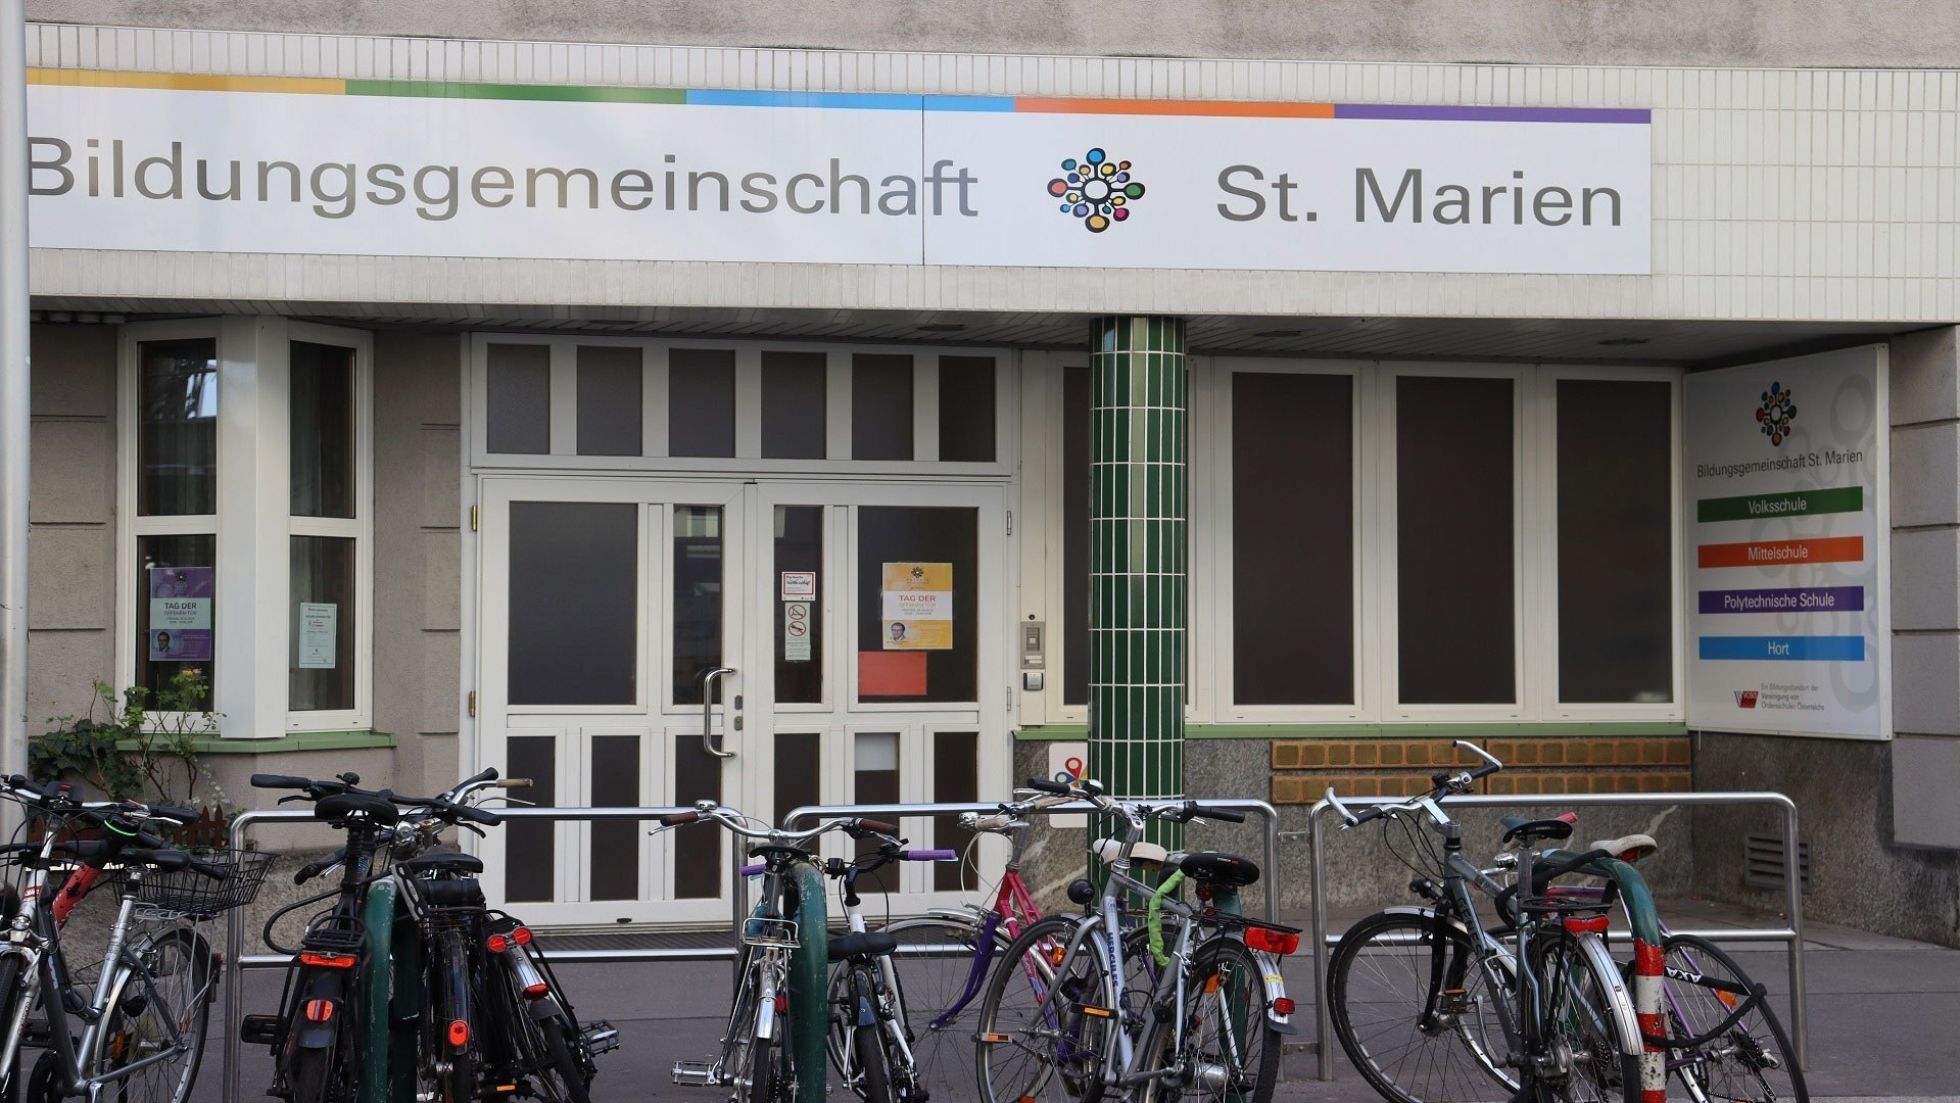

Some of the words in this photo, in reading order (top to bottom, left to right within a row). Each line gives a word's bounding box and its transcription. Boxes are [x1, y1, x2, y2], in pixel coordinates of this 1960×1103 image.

[28, 136, 978, 221] Bildungsgemeinschaft
[1217, 164, 1318, 223] St.
[1355, 167, 1622, 227] Marien
[1697, 456, 1805, 478] Bildungsgemeinschaft
[1808, 452, 1822, 467] St.
[1825, 449, 1863, 465] Marien
[1748, 497, 1807, 515] Volksschule
[1748, 545, 1808, 561] Mittelschule
[165, 602, 180, 610] TAG
[181, 602, 197, 610] DER
[1724, 594, 1798, 611] Polytechnische
[1800, 592, 1835, 607] Schule
[1768, 641, 1790, 656] Hort
[1107, 932, 1119, 987] HERCULES
[1666, 966, 1702, 983] AXA
